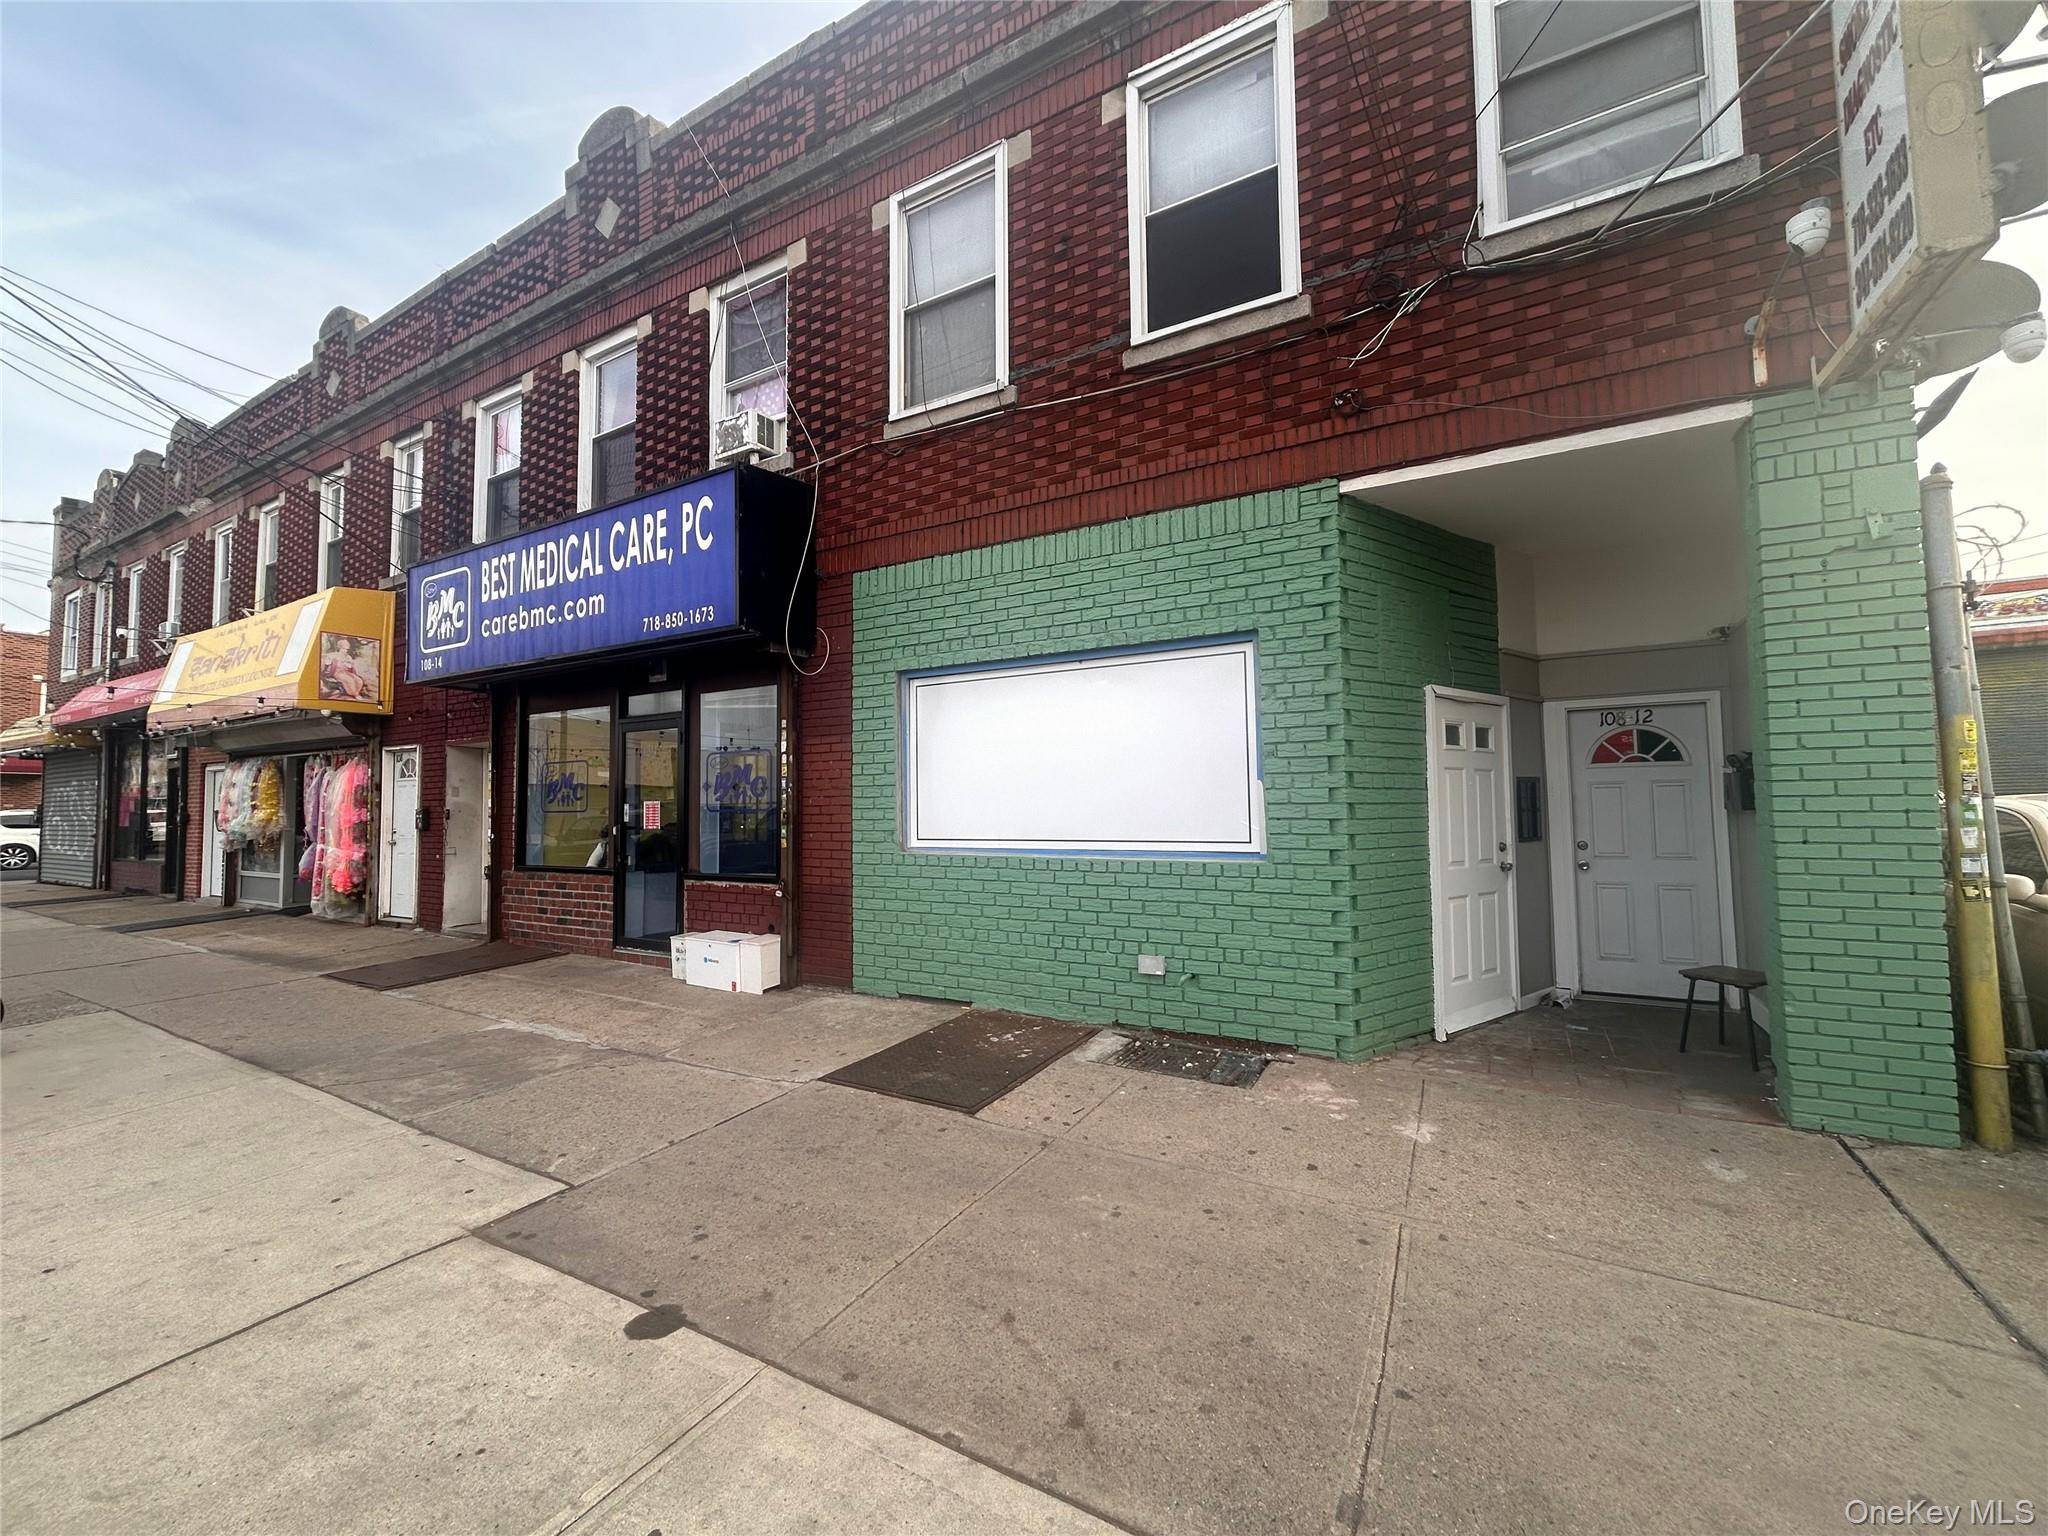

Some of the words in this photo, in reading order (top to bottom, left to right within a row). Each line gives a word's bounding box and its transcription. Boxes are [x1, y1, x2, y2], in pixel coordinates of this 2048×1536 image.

[1863, 105, 1883, 167] ETC
[481, 552, 516, 603] BEST
[520, 526, 604, 594] MEDICAL
[609, 508, 674, 572] CARE,
[682, 495, 714, 555] PC
[426, 586, 465, 638] BMC
[481, 593, 605, 638] carebmc.com
[642, 605, 714, 633] 718-850-1673
[421, 656, 442, 672] 108-14
[1599, 708, 1654, 727] 108-12
